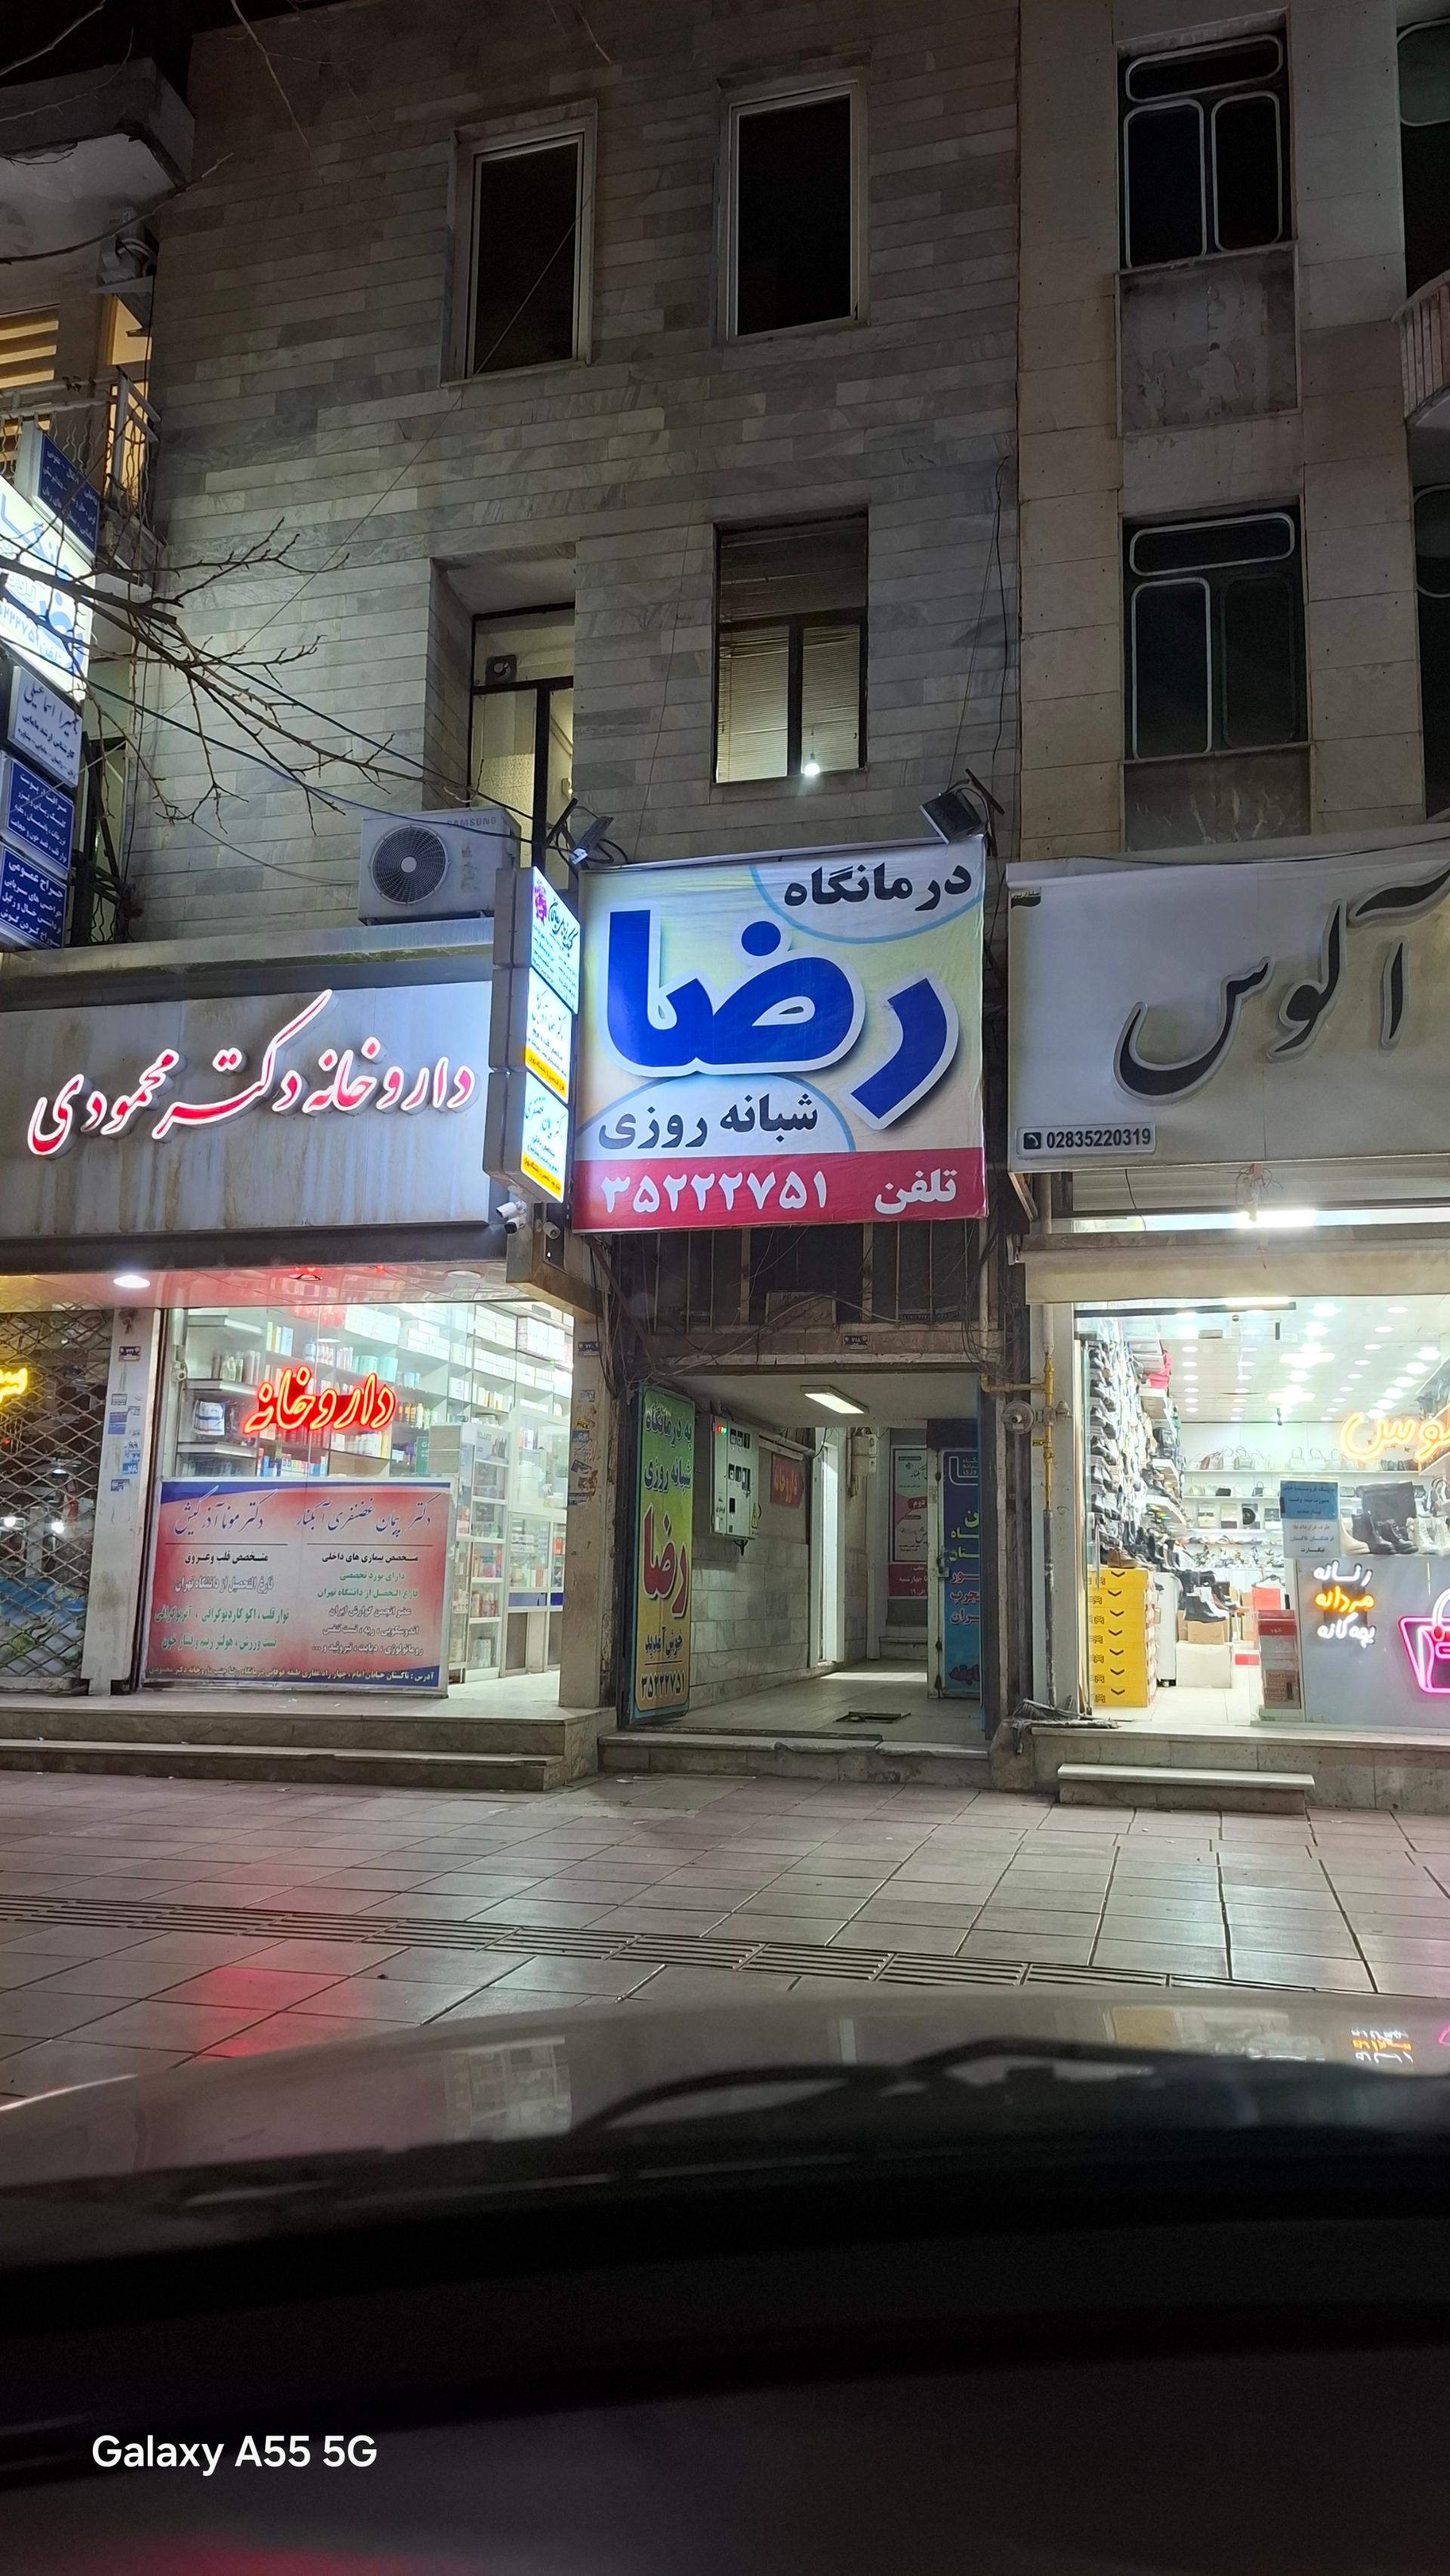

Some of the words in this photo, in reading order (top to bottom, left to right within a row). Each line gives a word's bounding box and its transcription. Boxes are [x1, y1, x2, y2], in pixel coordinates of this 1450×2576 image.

[447, 817, 496, 828] SAMSUNG
[8, 862, 38, 882] عمومی
[39, 879, 63, 900] جراح
[784, 863, 972, 911] درمانگاه
[606, 909, 948, 1120] رضا
[152, 990, 333, 1140] دکتر
[302, 1036, 476, 1114] داروخانه
[27, 1049, 179, 1156] محمودی
[720, 1092, 818, 1143] شبانه
[599, 1107, 708, 1150] روزی
[1046, 1128, 1151, 1149] 02835220319
[601, 1171, 828, 1213] ۳۵۲۲۲۷۵۱
[874, 1168, 957, 1215] تلفن
[245, 1367, 396, 1433] داروخانه
[646, 1404, 682, 1447] درمانگاه
[644, 1456, 668, 1493] روزی
[671, 1456, 691, 1496] شبانه
[222, 1505, 239, 1529] مونا
[239, 1488, 278, 1533] دکتر
[328, 1498, 374, 1531] غضنفری
[409, 1493, 442, 1529] دکتر
[375, 1510, 401, 1538] پیمان
[217, 1551, 230, 1562] قلب
[232, 1551, 268, 1564] متخصص
[322, 1552, 344, 1563] داخلی
[345, 1552, 359, 1563] های
[361, 1552, 384, 1564] بیماری
[385, 1554, 418, 1563] متخصص
[643, 1503, 688, 1617] رضا
[174, 1576, 194, 1593] تهران
[196, 1576, 219, 1590] دانشگاه
[219, 1576, 228, 1593] از
[228, 1576, 257, 1593] التحصیل
[257, 1576, 274, 1594] فارغ
[369, 1573, 384, 1582] بورد
[385, 1571, 405, 1582] دارای
[317, 1588, 336, 1598] تهران
[338, 1588, 362, 1598] دانشگاه
[373, 1589, 401, 1599] التحصیل
[402, 1590, 418, 1601] فارغ
[1315, 1585, 1374, 1613] مردانه
[262, 1607, 275, 1620] قلب
[276, 1607, 289, 1624] نوار
[329, 1605, 348, 1616] ایران
[374, 1607, 396, 1617] انجمن
[396, 1609, 412, 1619] عضو
[645, 1626, 665, 1658] آمدید
[665, 1629, 683, 1658] خوش
[386, 1671, 409, 1681] تاکستان
[415, 1671, 434, 1681] آدرس
[641, 1672, 685, 1700] ۳۵۲۲۲۷۵۱
